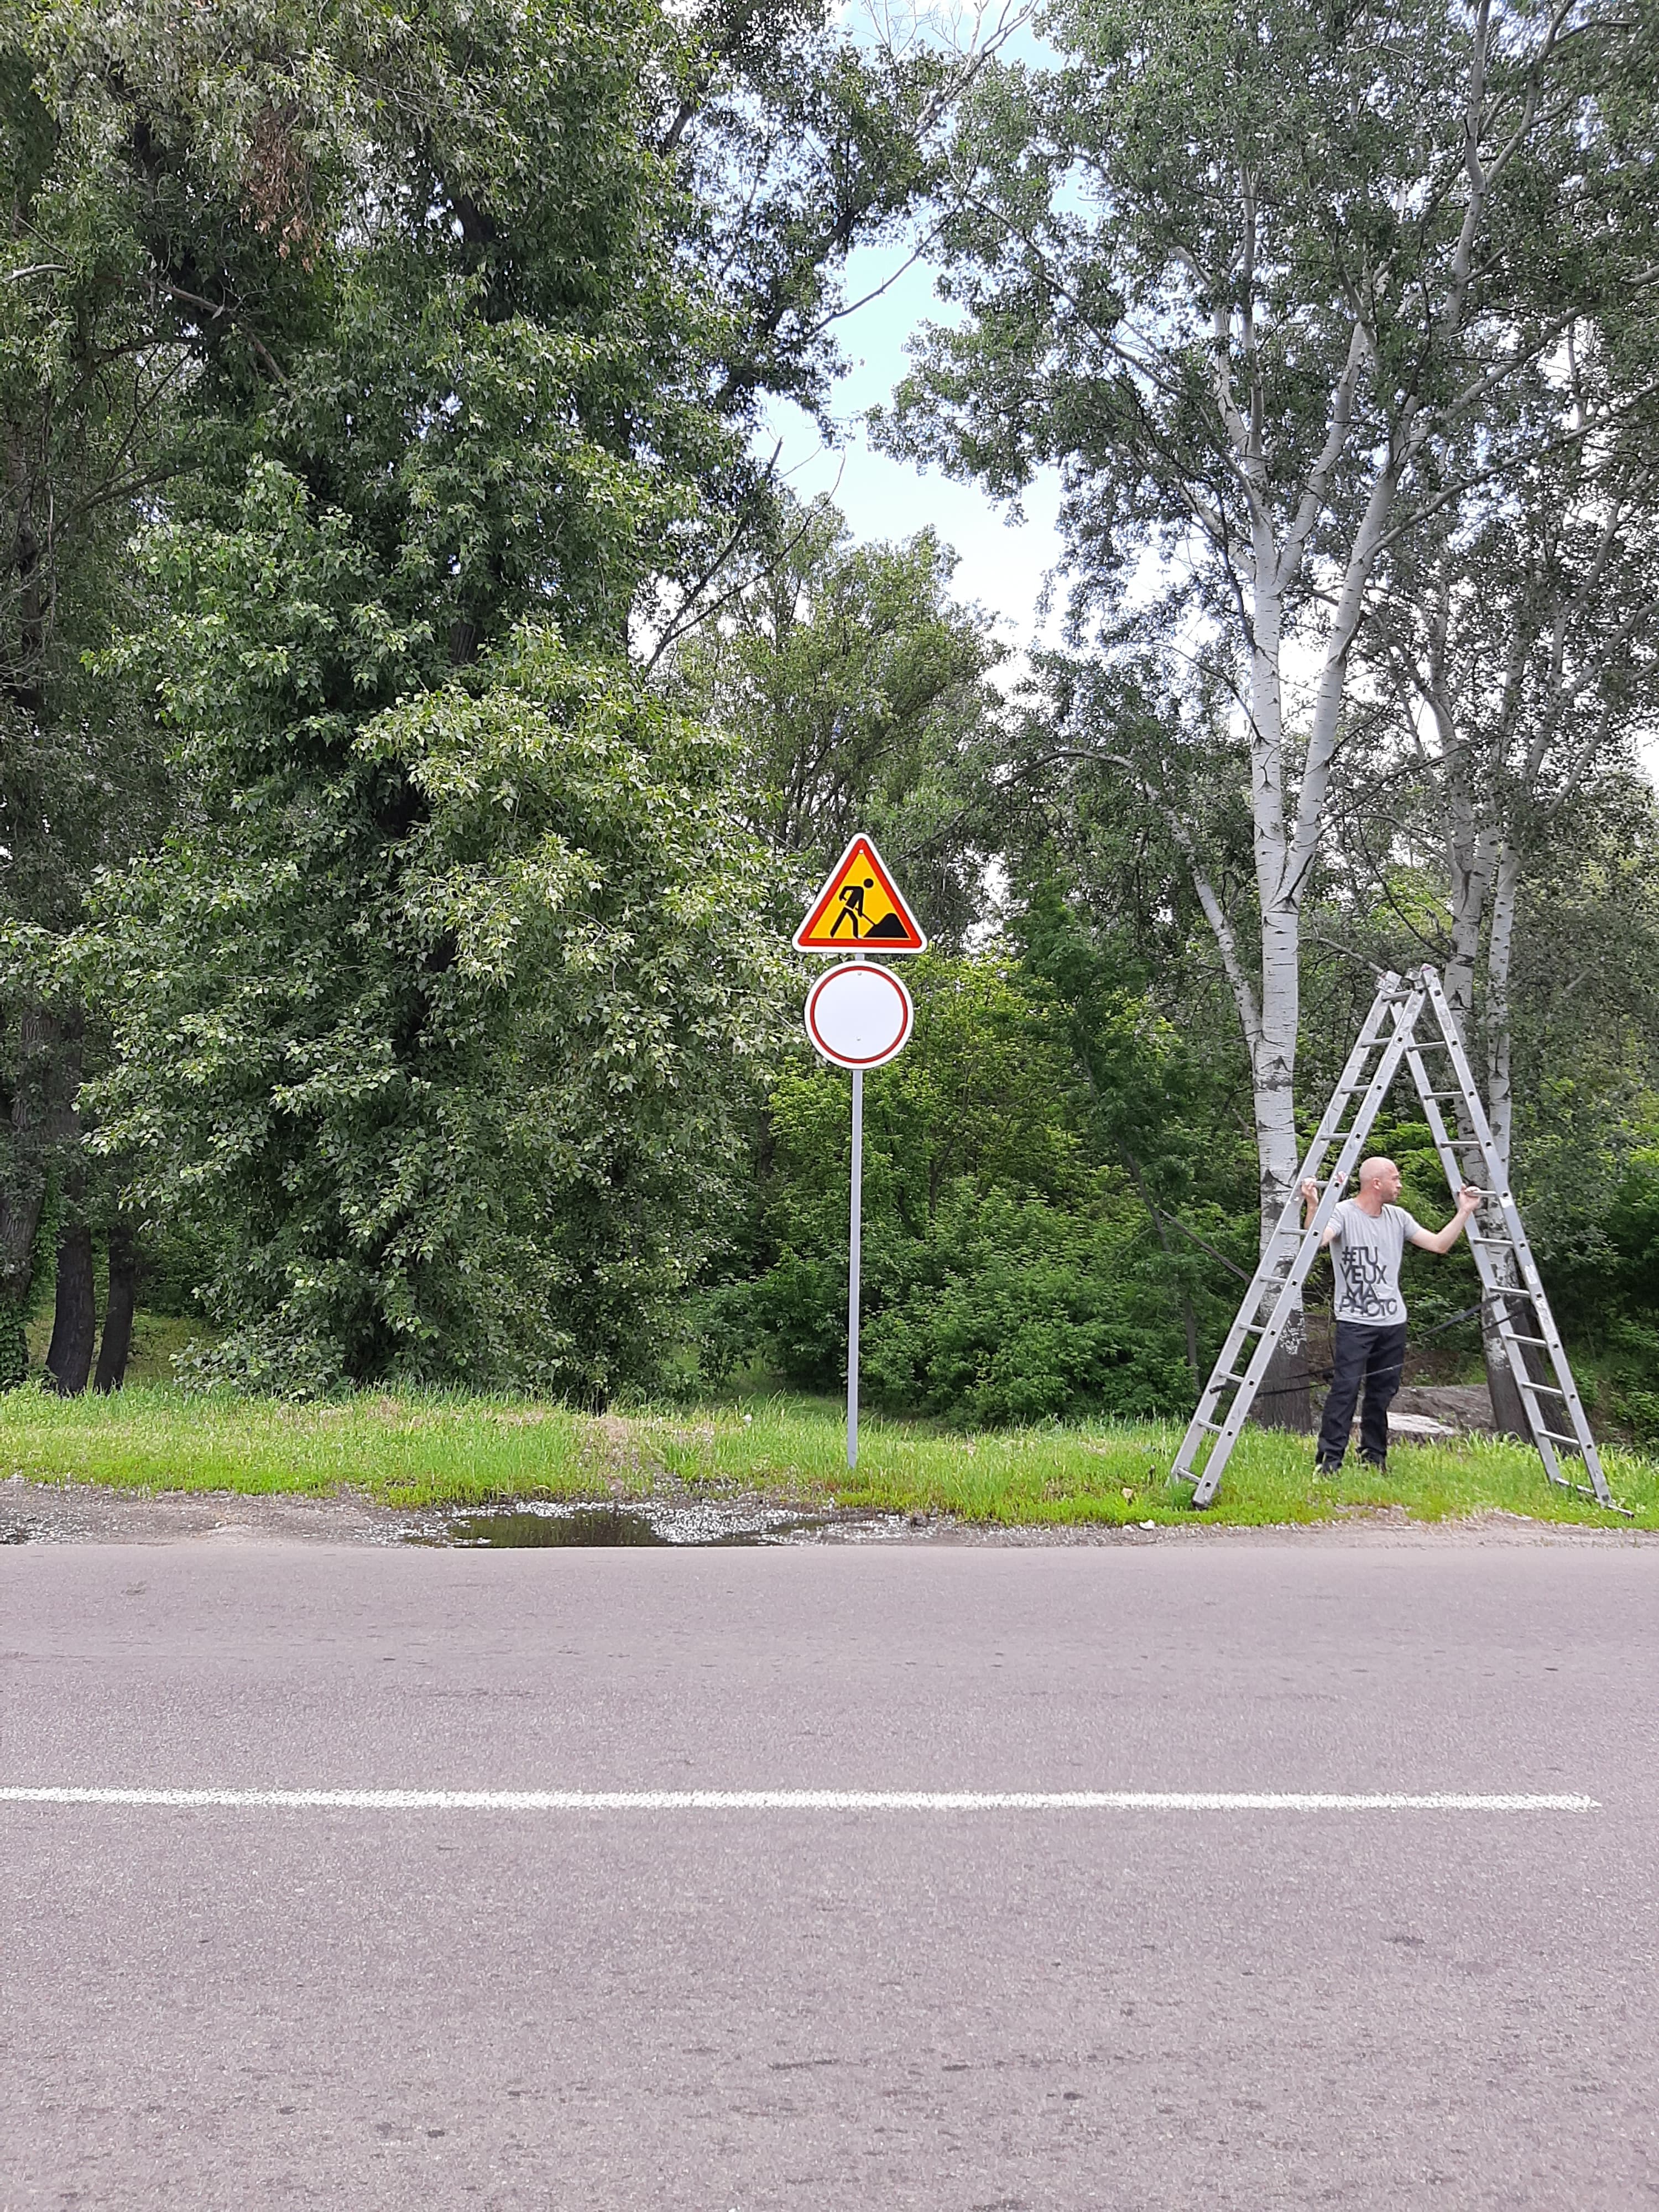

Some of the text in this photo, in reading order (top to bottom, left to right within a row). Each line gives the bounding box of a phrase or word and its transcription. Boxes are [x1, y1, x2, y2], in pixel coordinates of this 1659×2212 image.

[1339, 1264, 1387, 1284] VEUX
[1345, 1281, 1378, 1301] MA
[1339, 1295, 1397, 1316] PHOTO
